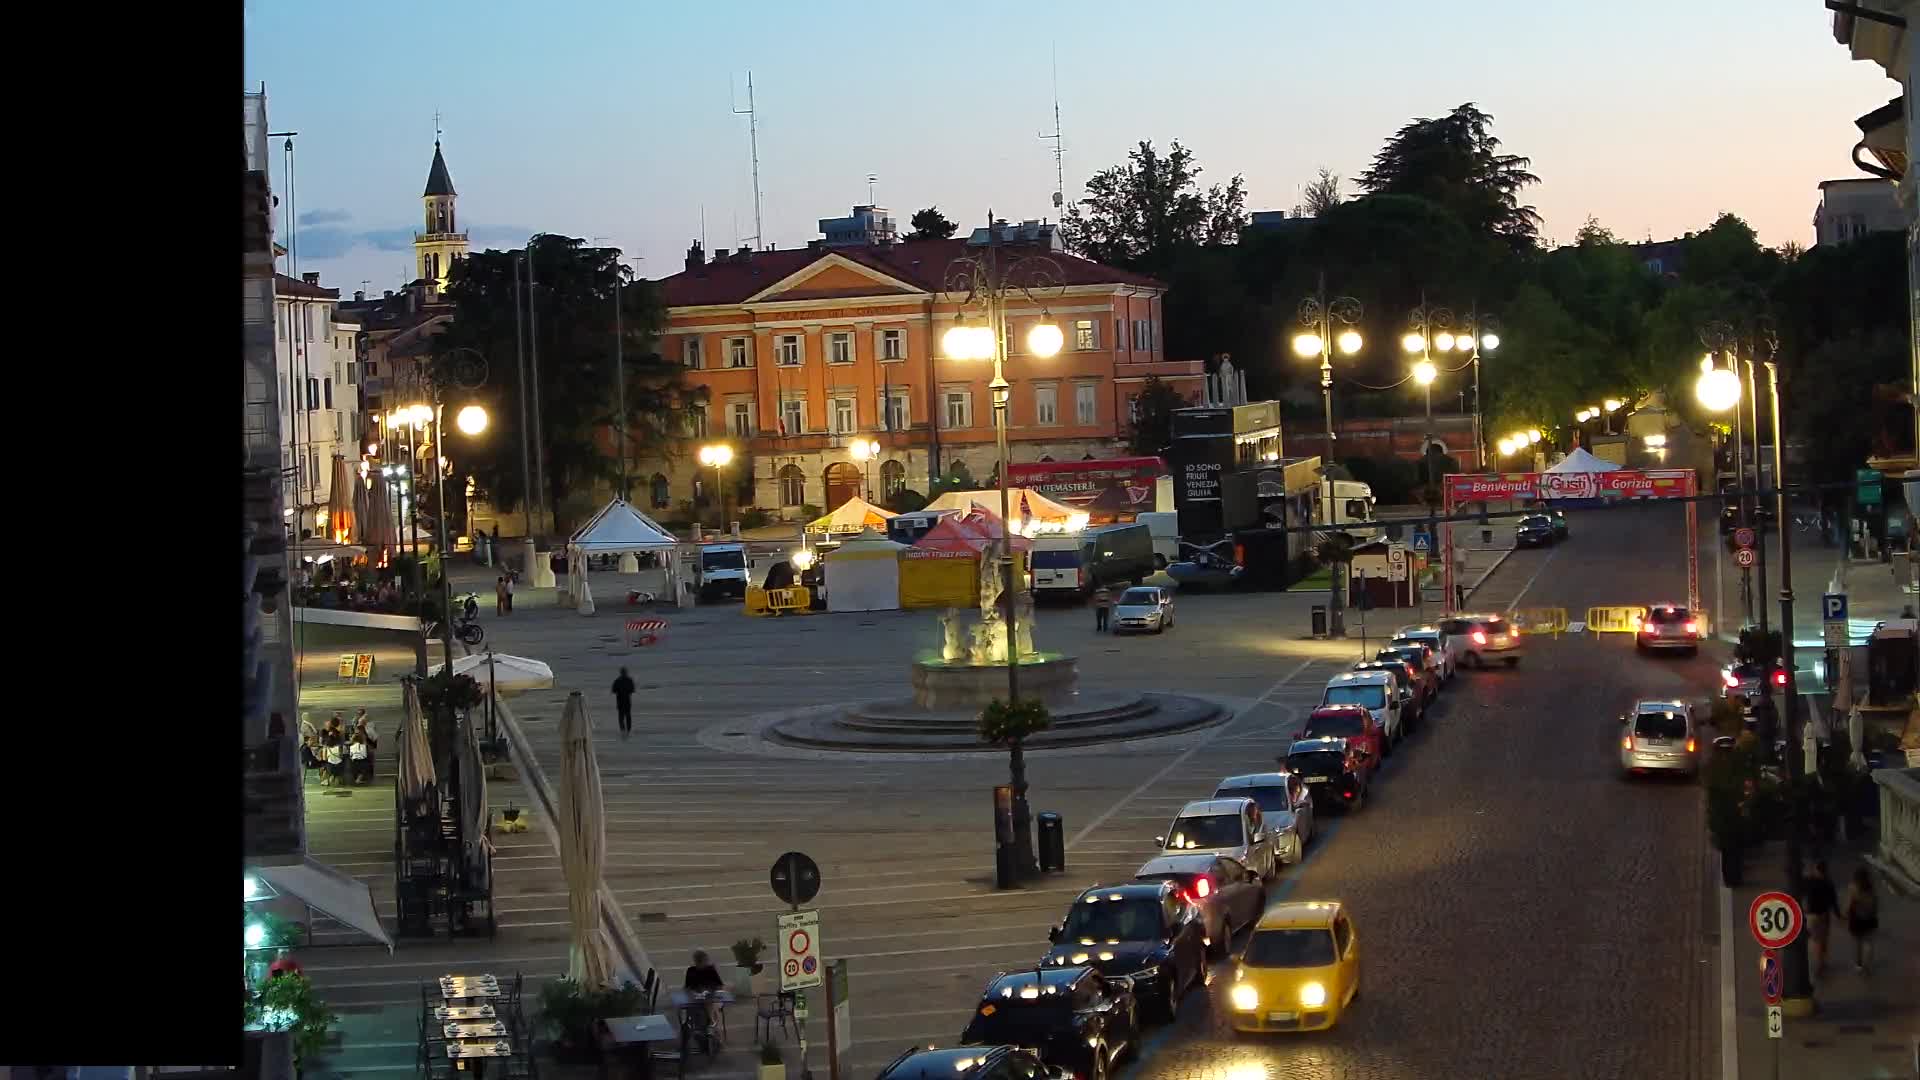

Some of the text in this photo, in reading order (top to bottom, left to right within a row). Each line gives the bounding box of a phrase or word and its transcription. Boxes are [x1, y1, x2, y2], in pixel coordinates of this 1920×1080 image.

[1196, 463, 1222, 471] SONO
[1185, 472, 1208, 480] FRIULI
[1186, 480, 1219, 488] VENEZIA
[1473, 480, 1531, 492] Benvenuti
[1611, 479, 1653, 489] Gorizia
[1187, 489, 1212, 497] GIULIA
[1740, 553, 1751, 562] 20
[1828, 599, 1842, 617] P
[1760, 907, 1790, 933] 30
